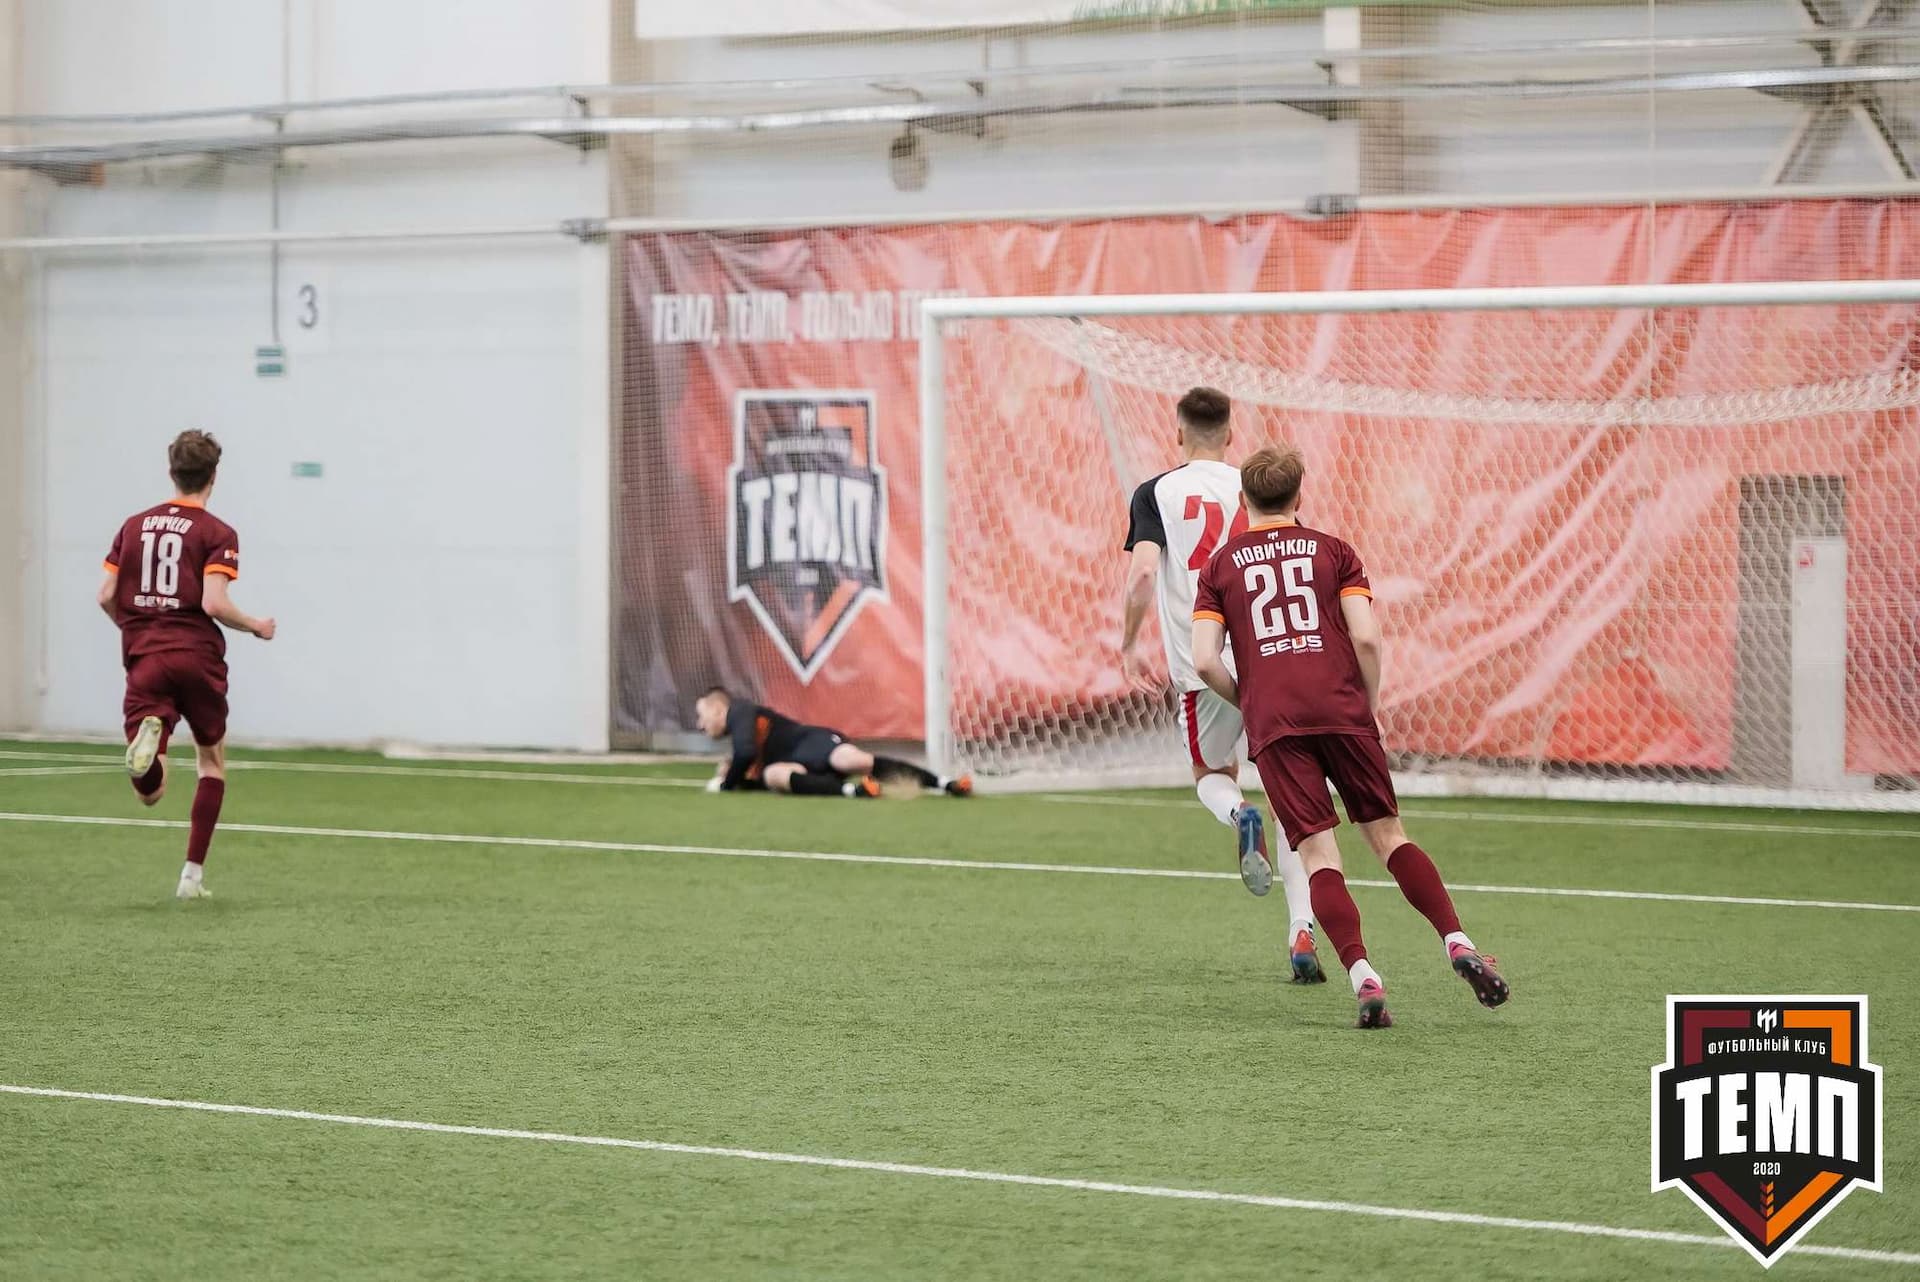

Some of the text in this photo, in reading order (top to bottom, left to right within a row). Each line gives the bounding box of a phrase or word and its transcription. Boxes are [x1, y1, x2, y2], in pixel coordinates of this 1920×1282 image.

[299, 284, 318, 328] 3
[742, 473, 874, 570] ТЕМП
[141, 532, 183, 596] 18
[1231, 539, 1318, 568] НОВИЧКОВ
[1244, 557, 1320, 640] 25
[1260, 635, 1323, 657] SEUS
